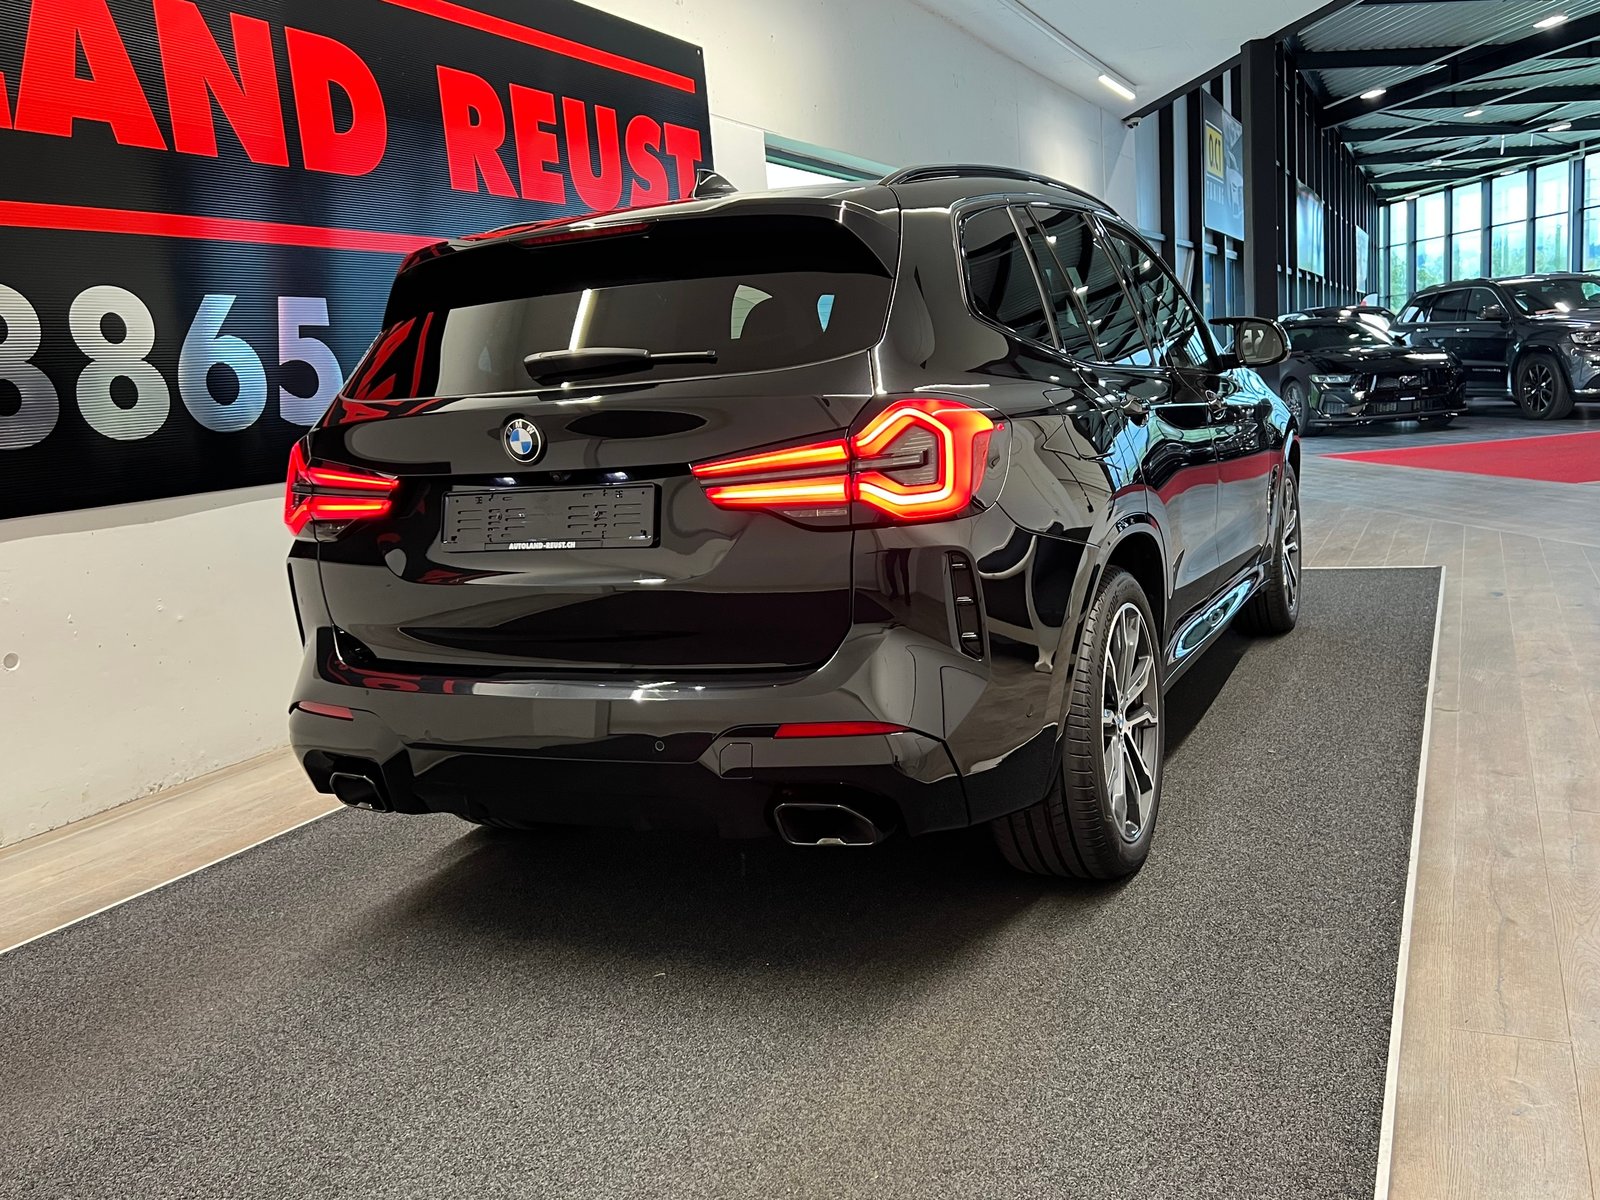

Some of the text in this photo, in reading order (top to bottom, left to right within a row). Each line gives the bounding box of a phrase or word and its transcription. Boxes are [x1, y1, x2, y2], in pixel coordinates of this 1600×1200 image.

[0, 0, 702, 212] AND REUST
[508, 541, 576, 550] AUTOLAND-REUST.CH
